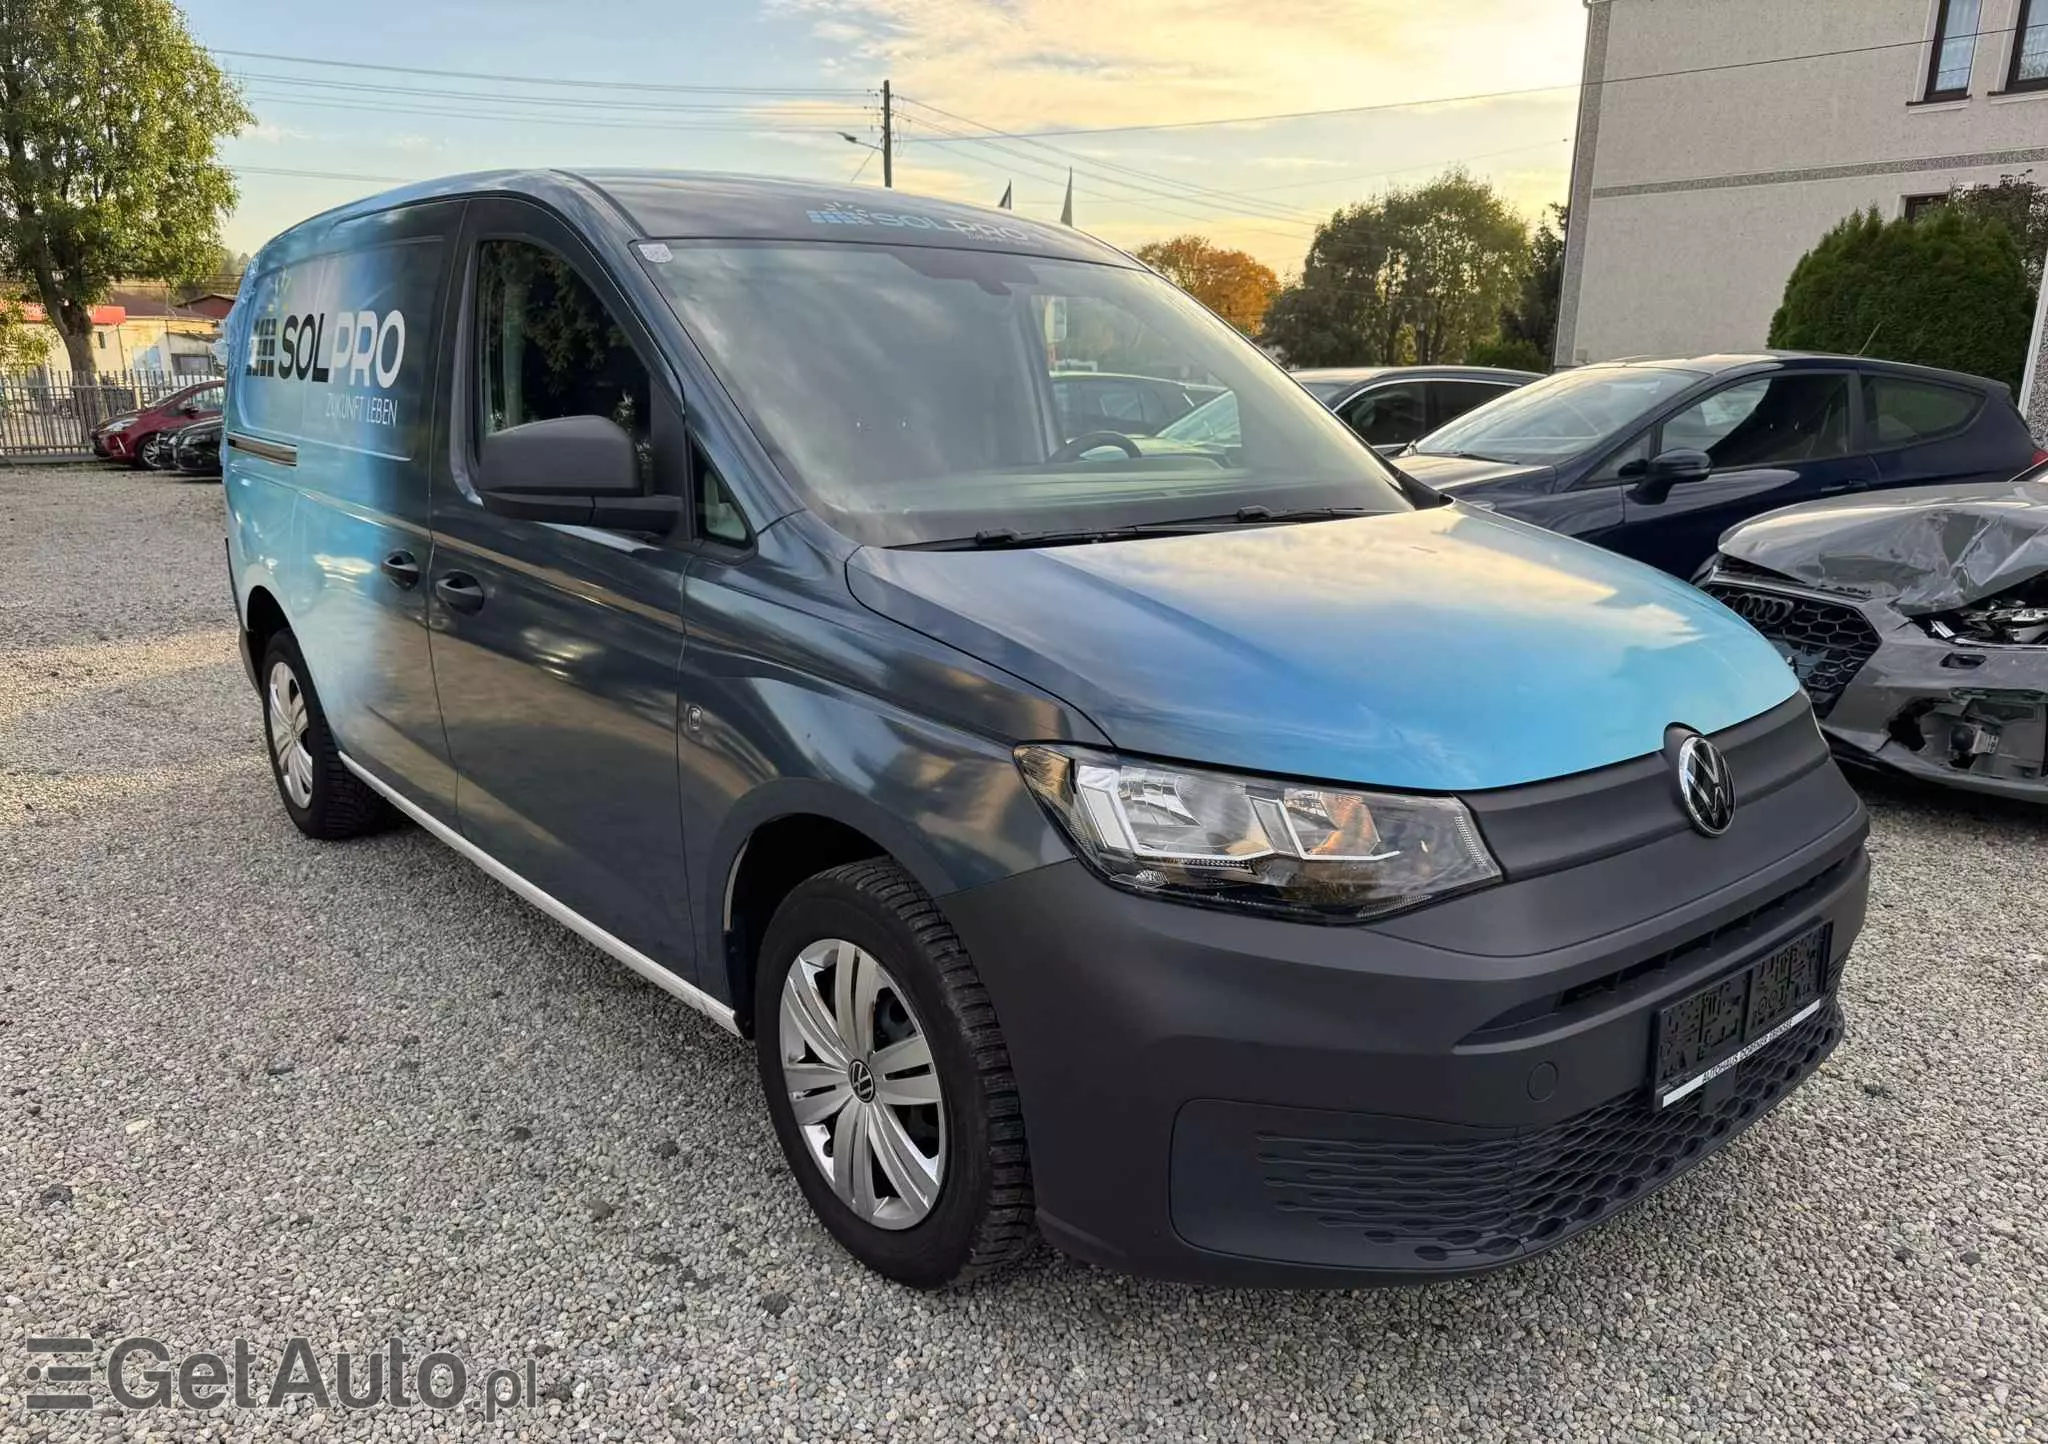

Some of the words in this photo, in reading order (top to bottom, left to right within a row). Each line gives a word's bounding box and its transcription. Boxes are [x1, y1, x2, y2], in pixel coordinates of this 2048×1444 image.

[875, 214, 1029, 241] SOLPRO
[278, 309, 406, 389] SOLPRO
[325, 392, 364, 421] ZUKUNFT
[365, 397, 399, 427] LEBEN
